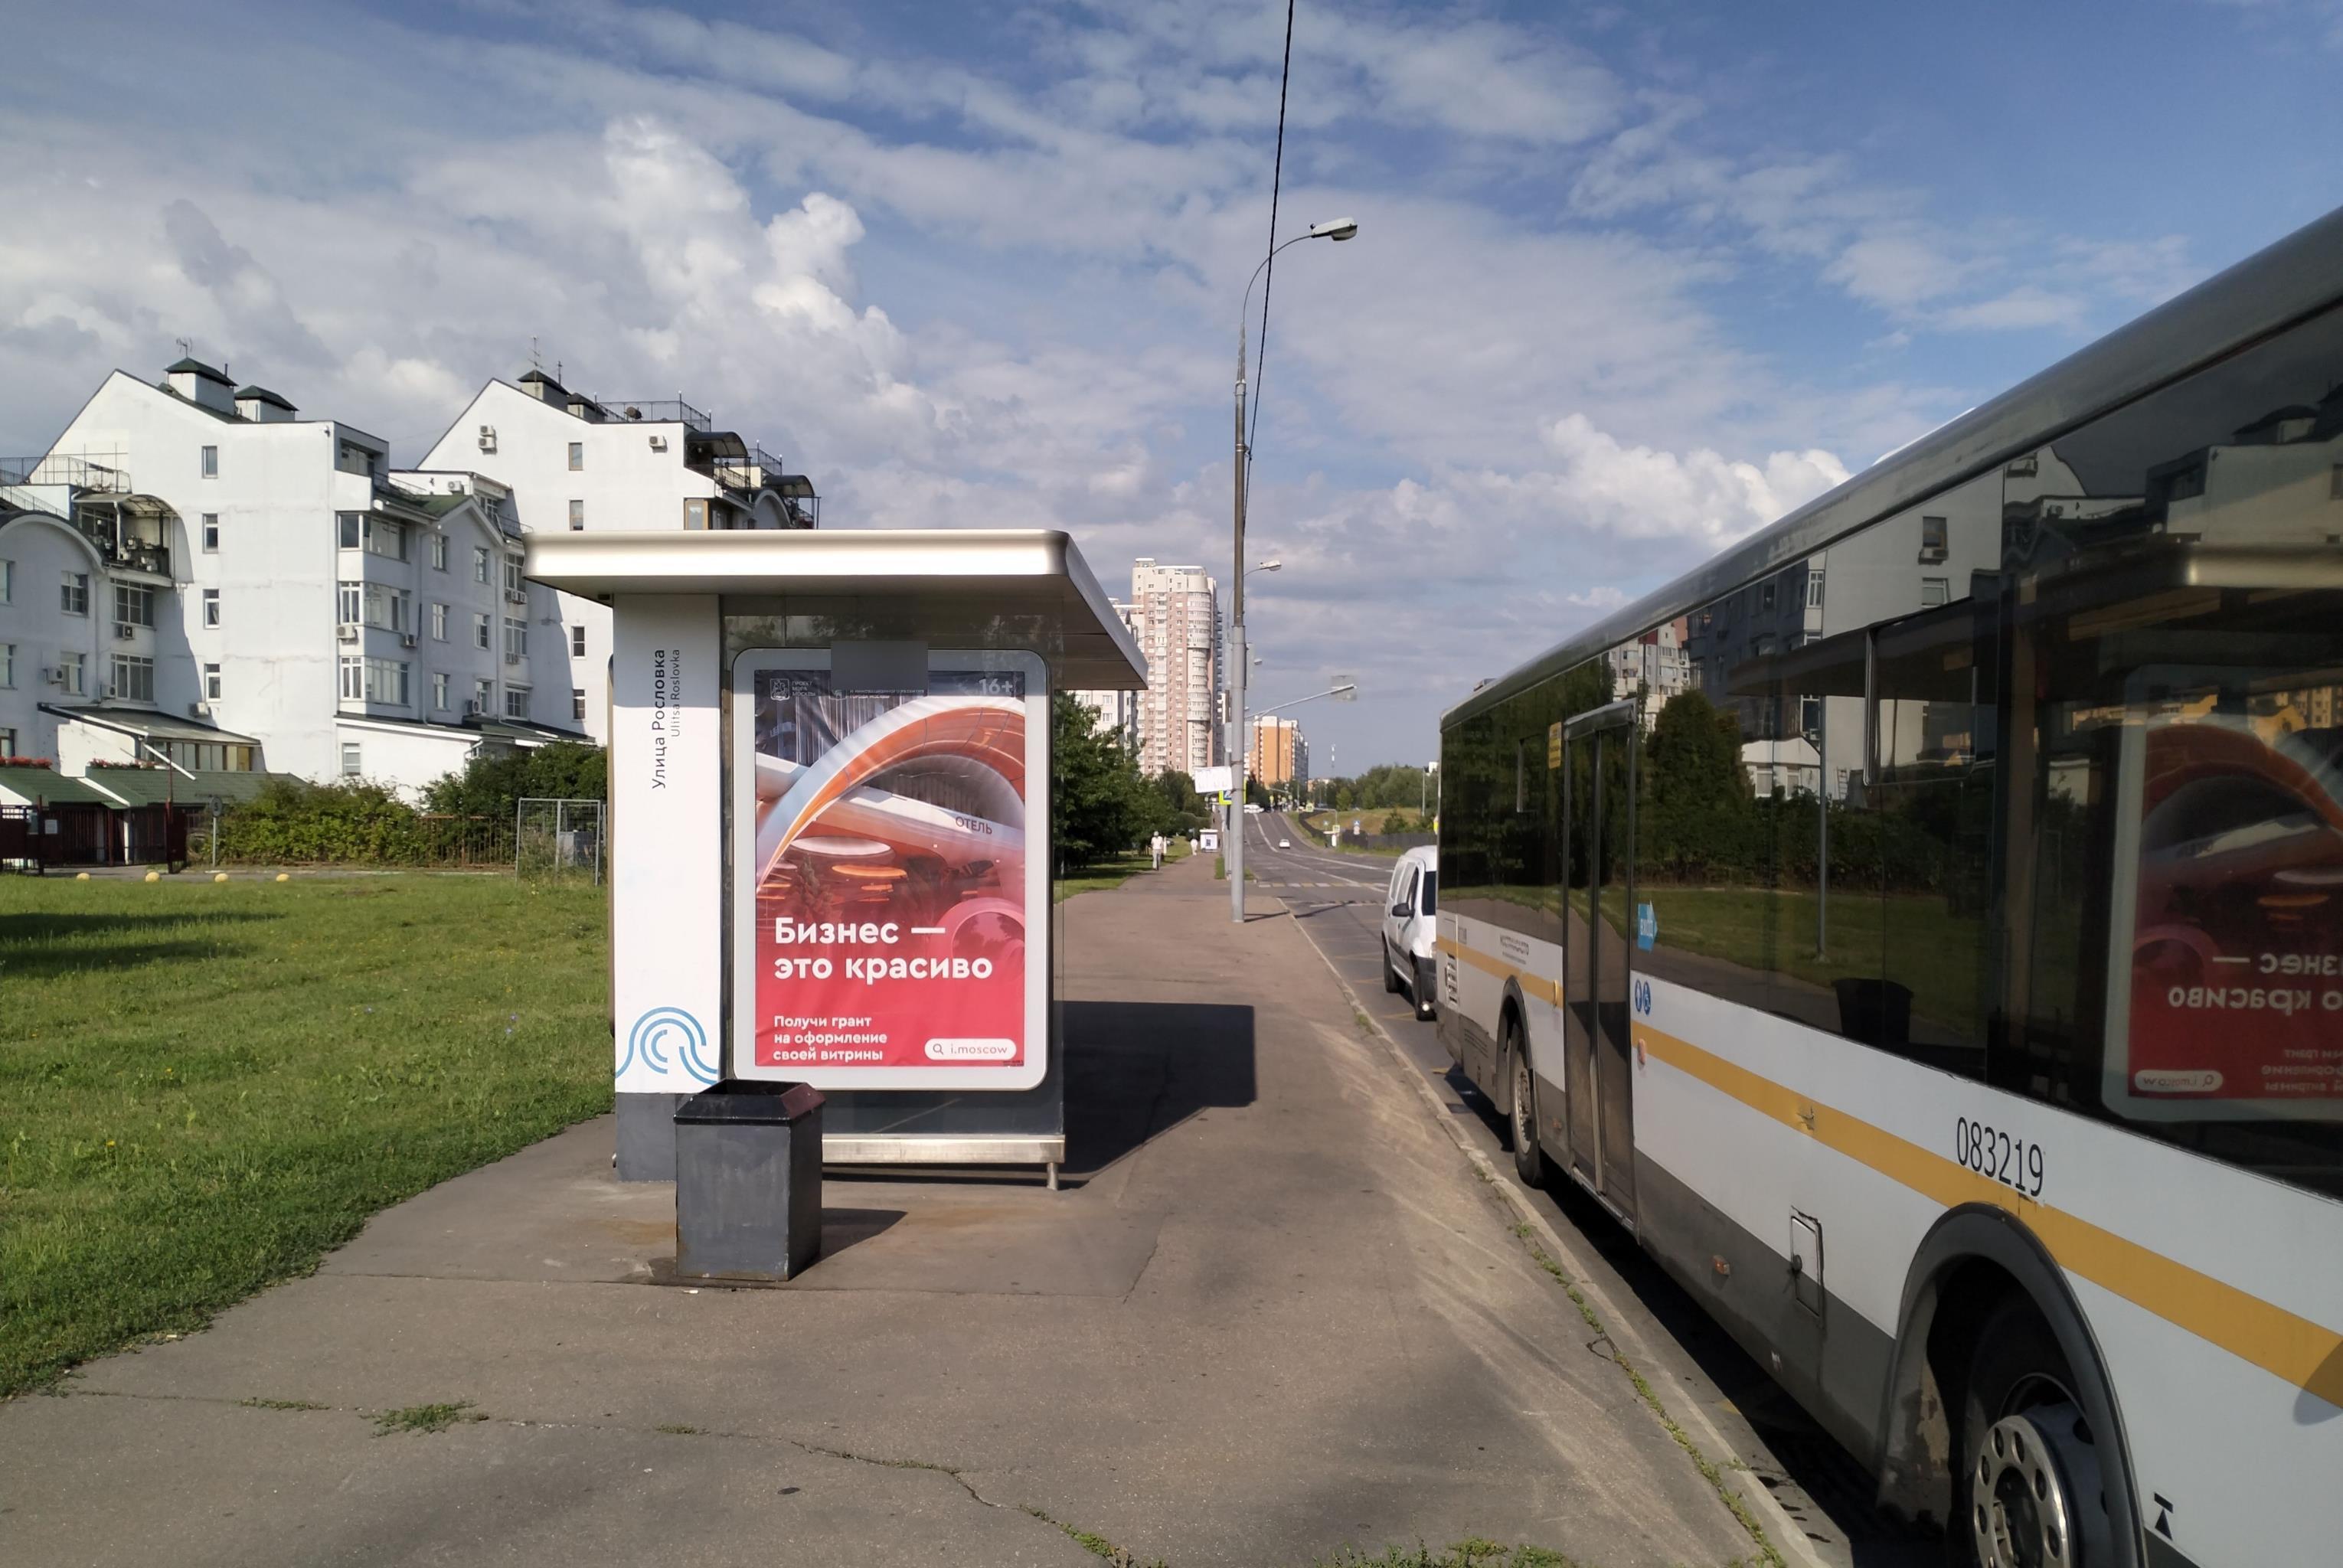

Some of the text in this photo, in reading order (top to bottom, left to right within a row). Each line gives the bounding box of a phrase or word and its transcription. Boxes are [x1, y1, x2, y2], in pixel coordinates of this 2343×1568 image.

[670, 649, 681, 737] Ulitsa Roslovka
[979, 678, 1013, 695] 16+
[652, 649, 667, 789] Улица Рословка
[956, 816, 992, 835] ОТЕЛЬ
[775, 916, 900, 945] Бизнес
[773, 957, 993, 985] это красиво
[774, 1015, 872, 1030] Получи грант
[774, 1031, 887, 1046] на оформление
[773, 1047, 883, 1063] своей витрины
[950, 1043, 1008, 1054] i.moscow
[1957, 1116, 2044, 1197] 083219
